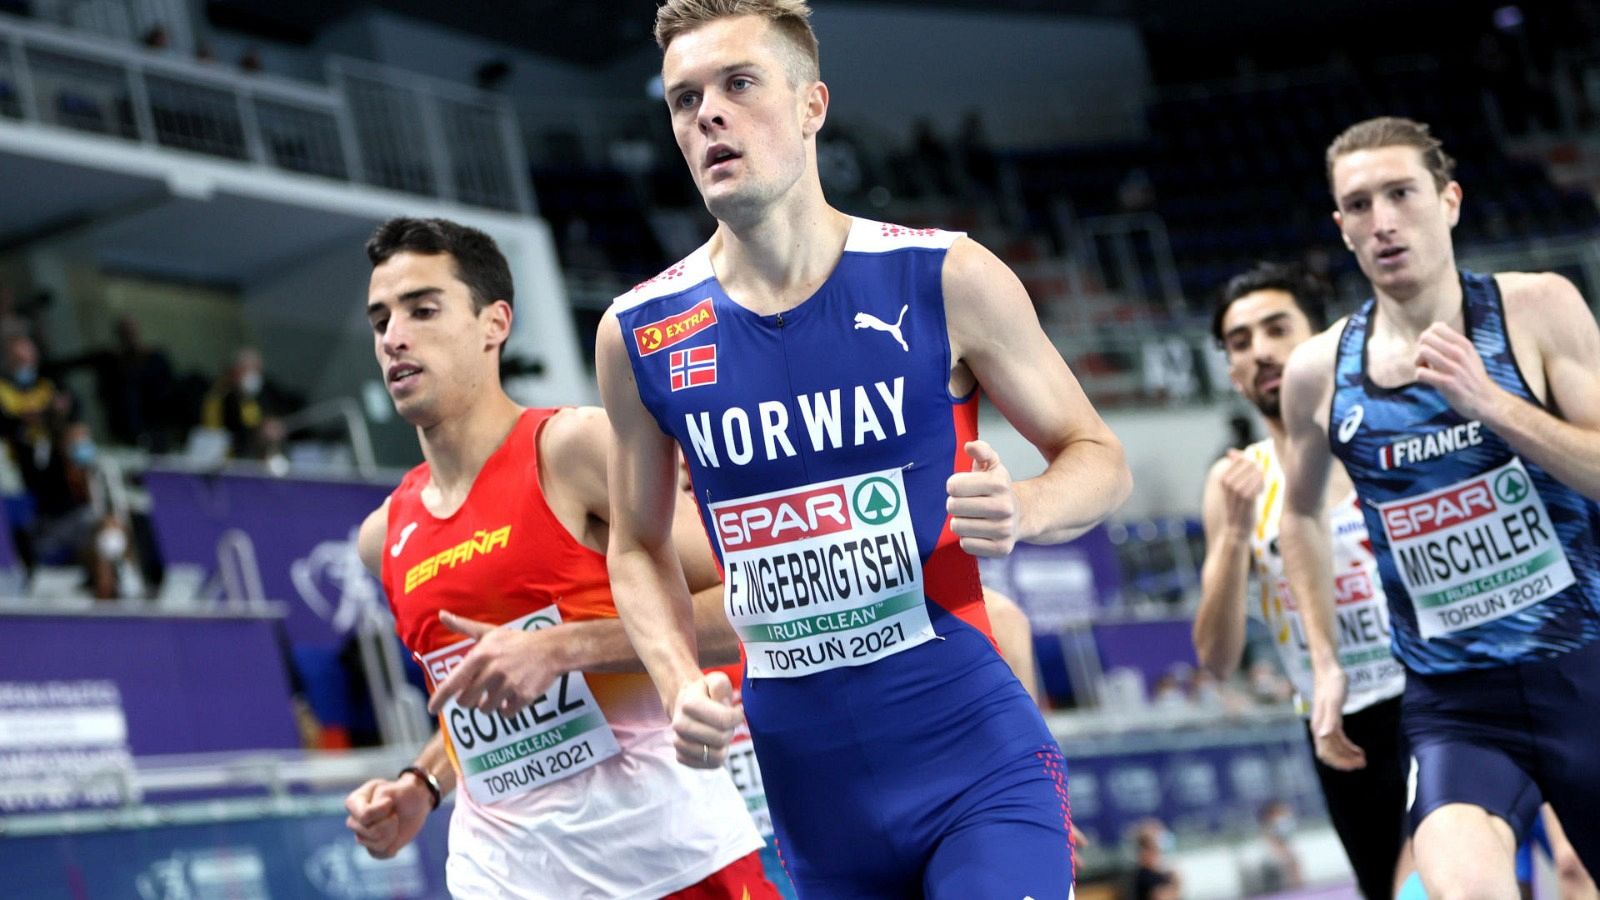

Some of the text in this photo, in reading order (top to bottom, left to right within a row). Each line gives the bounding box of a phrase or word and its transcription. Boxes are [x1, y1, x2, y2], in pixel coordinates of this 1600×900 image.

[665, 308, 710, 339] EXTRA
[685, 376, 907, 468] NORWAY
[1392, 420, 1483, 468] FRANCE
[719, 492, 846, 545] SPAR
[1387, 487, 1493, 537] SPAR
[404, 525, 512, 594] ESPAÑA
[1398, 505, 1549, 587] MISCHLER
[729, 531, 914, 618] F. INGEBRIGTSEN
[1509, 575, 1553, 605] 2021
[772, 619, 813, 640] RUN
[849, 622, 906, 658] 2021
[487, 744, 516, 767] RUN
[546, 740, 594, 774] 2021
